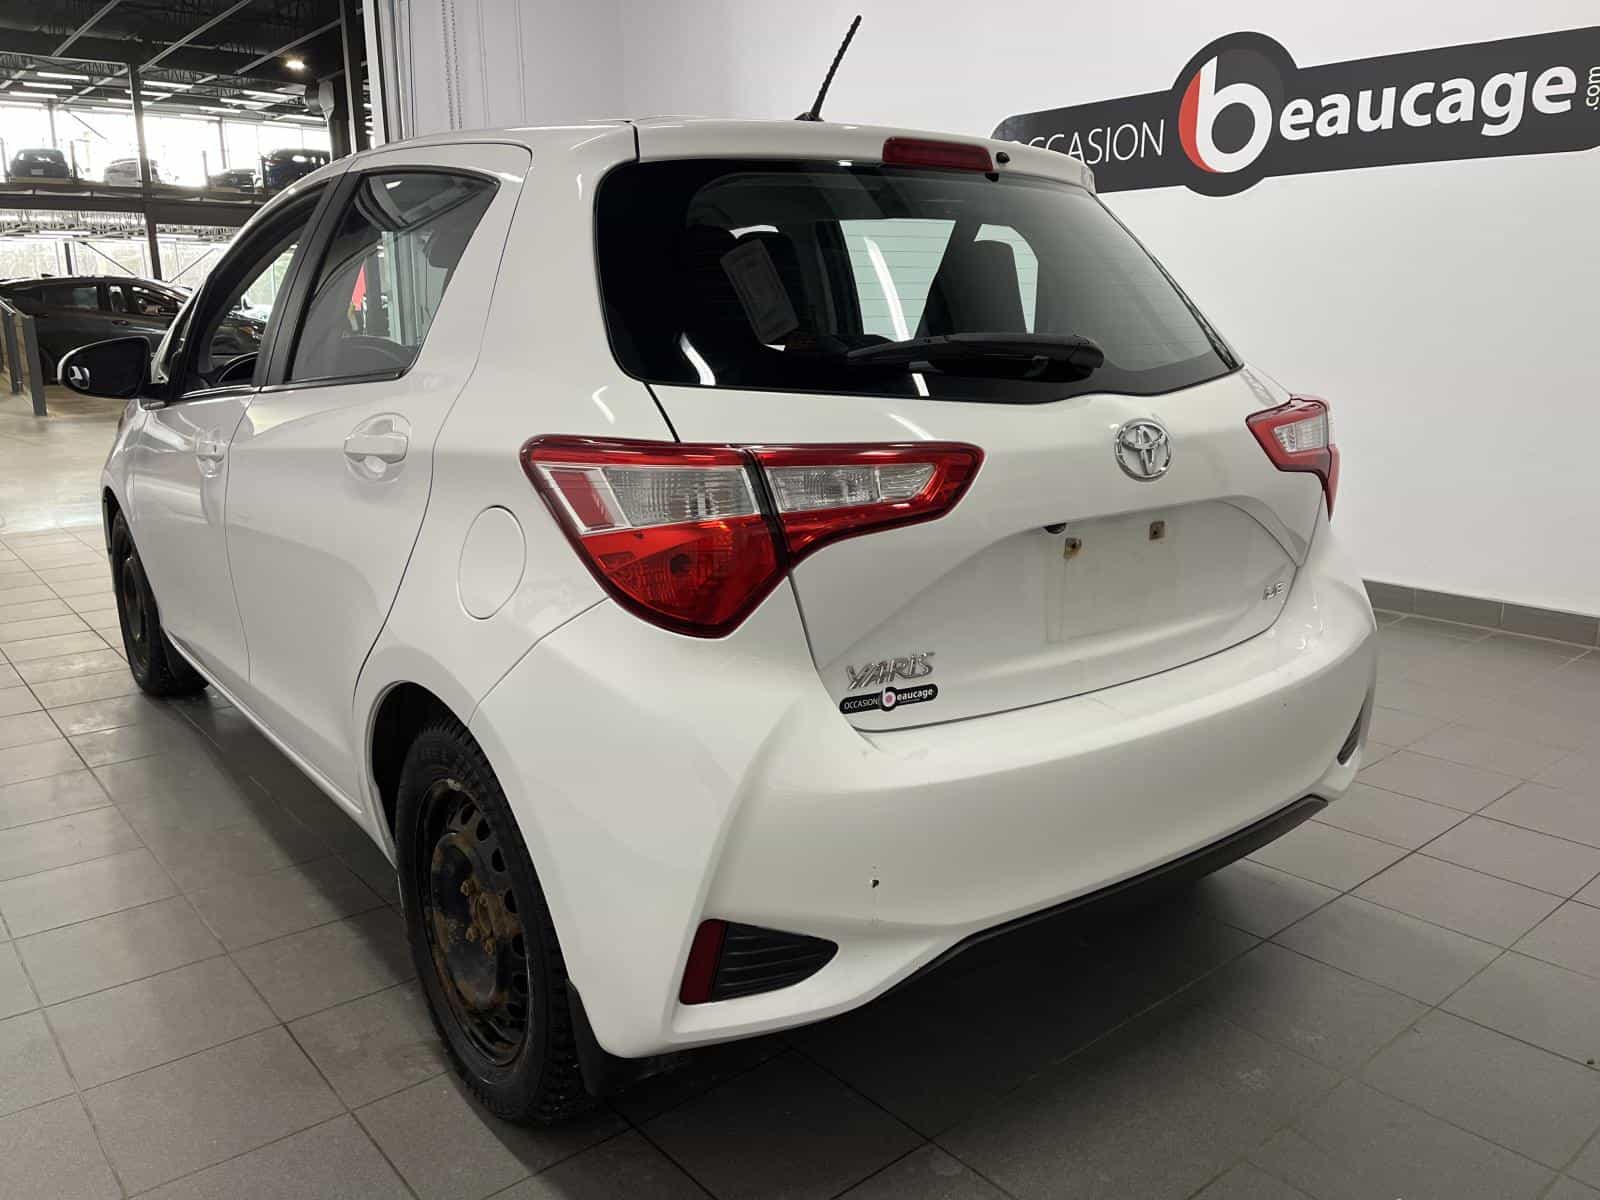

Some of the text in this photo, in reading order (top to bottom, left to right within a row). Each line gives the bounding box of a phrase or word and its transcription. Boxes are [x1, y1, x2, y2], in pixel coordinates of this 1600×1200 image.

[1011, 119, 1165, 165] ASION
[846, 652, 936, 690] YARIS
[844, 696, 879, 710] OCCASION
